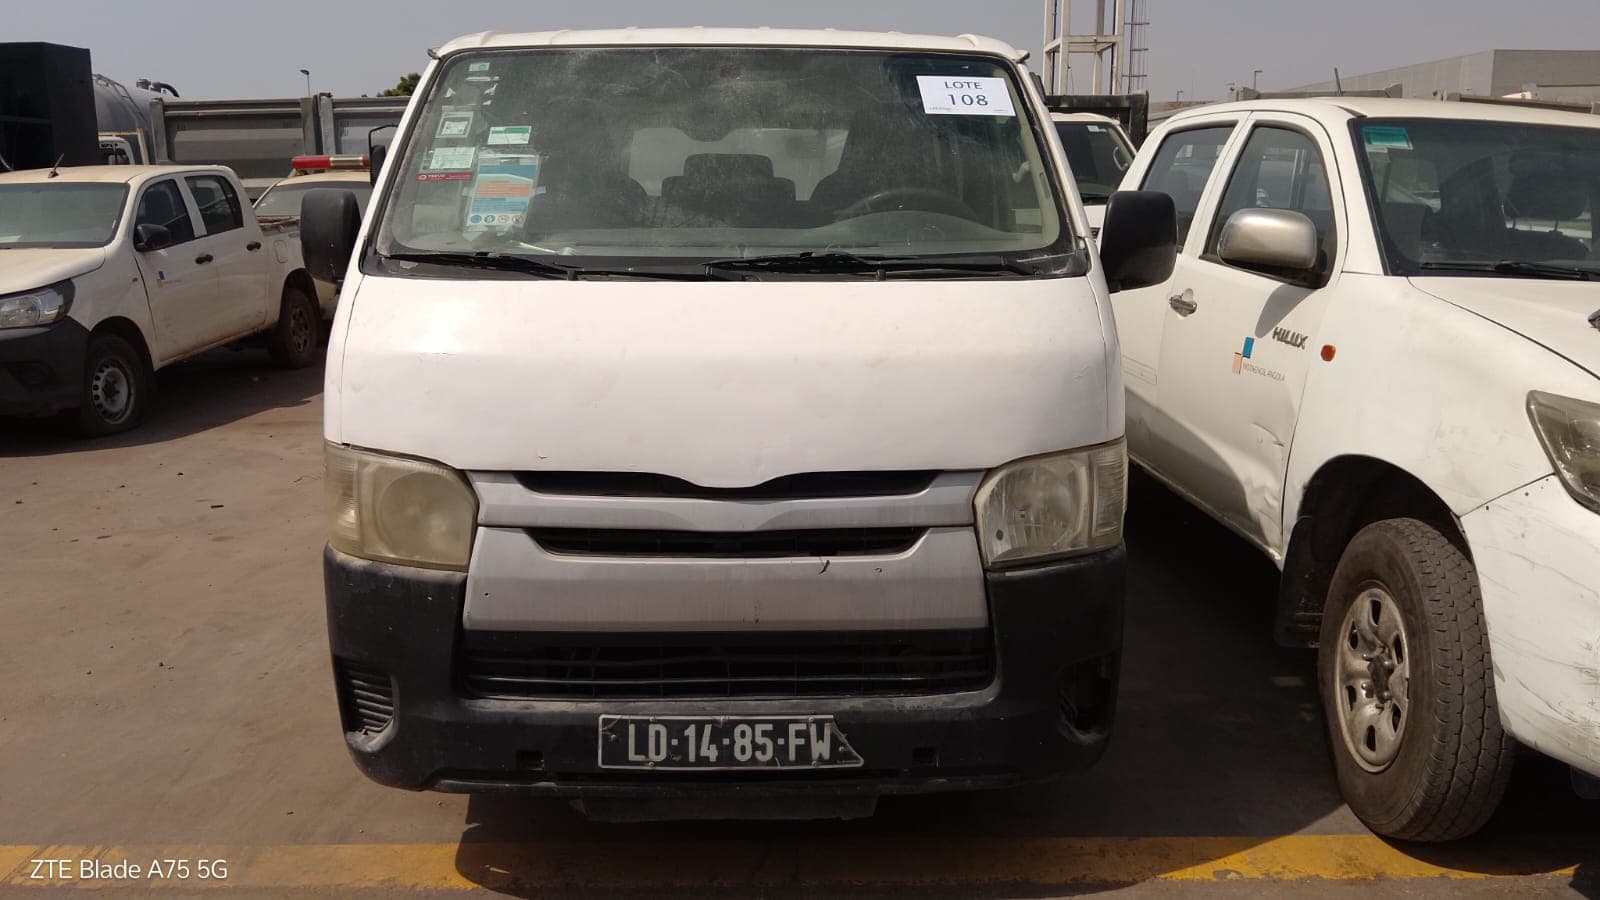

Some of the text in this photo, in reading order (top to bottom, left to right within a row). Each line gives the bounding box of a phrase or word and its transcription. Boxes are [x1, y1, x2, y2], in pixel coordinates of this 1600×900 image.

[944, 81, 983, 90] LOTE
[948, 94, 989, 106] 108
[1272, 326, 1309, 350] HILUX
